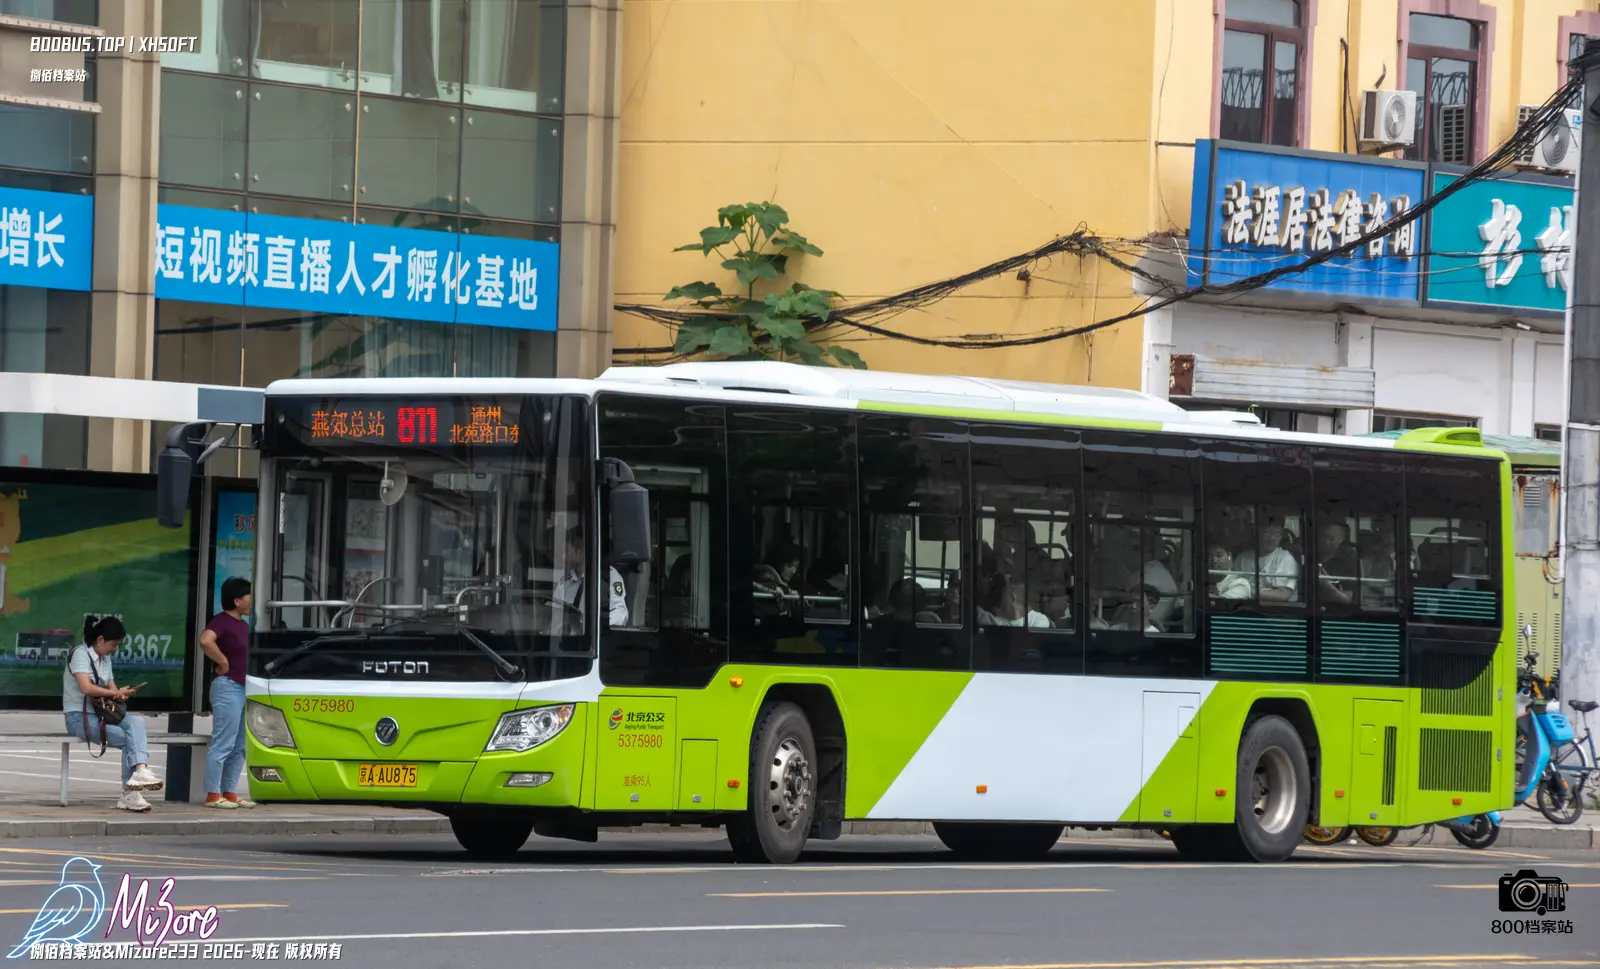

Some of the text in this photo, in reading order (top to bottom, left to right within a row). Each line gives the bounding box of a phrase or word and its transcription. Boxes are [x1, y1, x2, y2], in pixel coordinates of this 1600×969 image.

[0, 207, 65, 268] 增长
[155, 223, 538, 310] 短视频直播人才孵化基地
[311, 410, 385, 437] 燕郊总站
[397, 407, 437, 443] 811
[471, 405, 501, 425] 通州
[362, 661, 429, 674] FOTON
[293, 698, 355, 713] 5375980
[626, 712, 665, 722] 北京公交
[618, 734, 663, 748] 5375980
